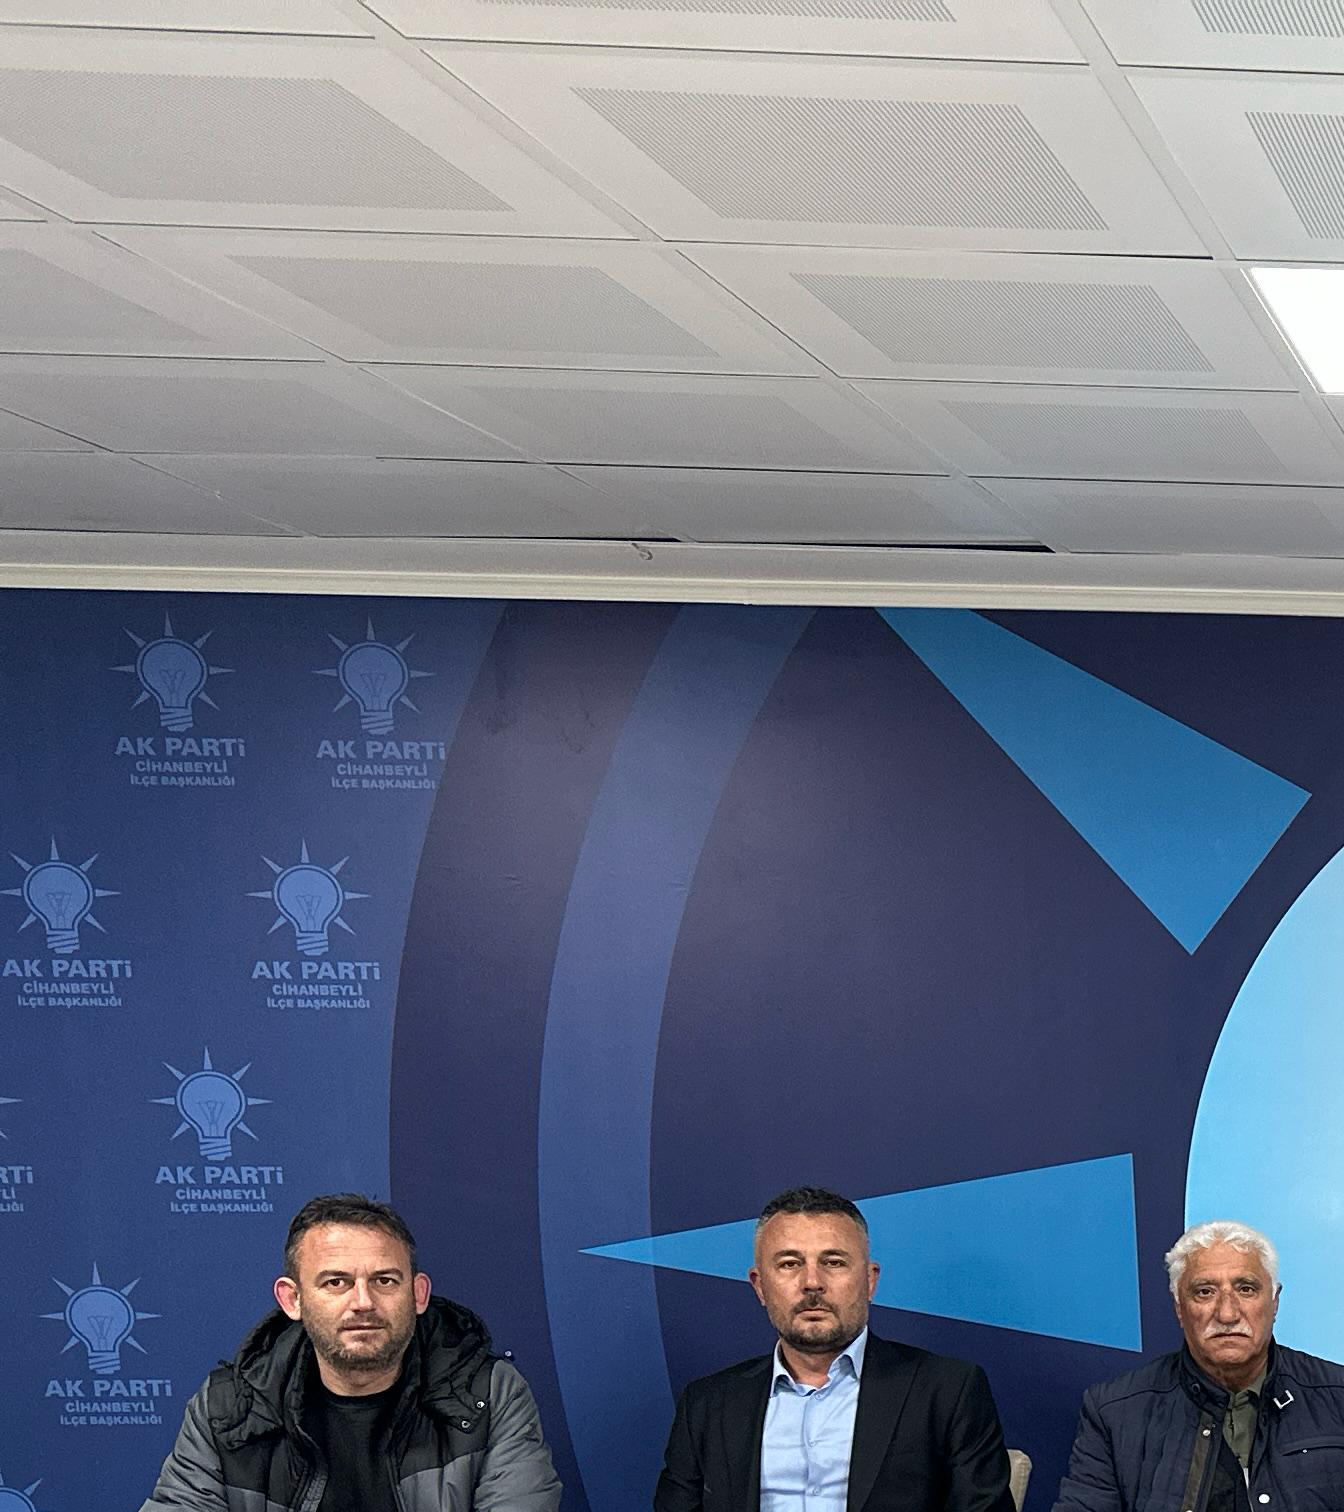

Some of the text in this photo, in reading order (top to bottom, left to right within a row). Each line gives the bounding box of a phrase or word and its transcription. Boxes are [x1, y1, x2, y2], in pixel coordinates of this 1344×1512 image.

[114, 736, 156, 755] AK
[316, 739, 357, 758] AK
[135, 759, 228, 773] CİHANBEYLİ
[337, 762, 429, 776] CİHANBEYLİ
[2, 959, 43, 977] AK
[251, 961, 292, 979] AK
[23, 981, 115, 995] CİHANBEYLİ
[272, 983, 363, 997] CİHANBEYLİ
[155, 1166, 195, 1184] AK
[175, 1188, 266, 1201] CİHANBEYLİ
[45, 1379, 86, 1397] AK
[65, 1400, 156, 1414] CİHANBEYLİ
